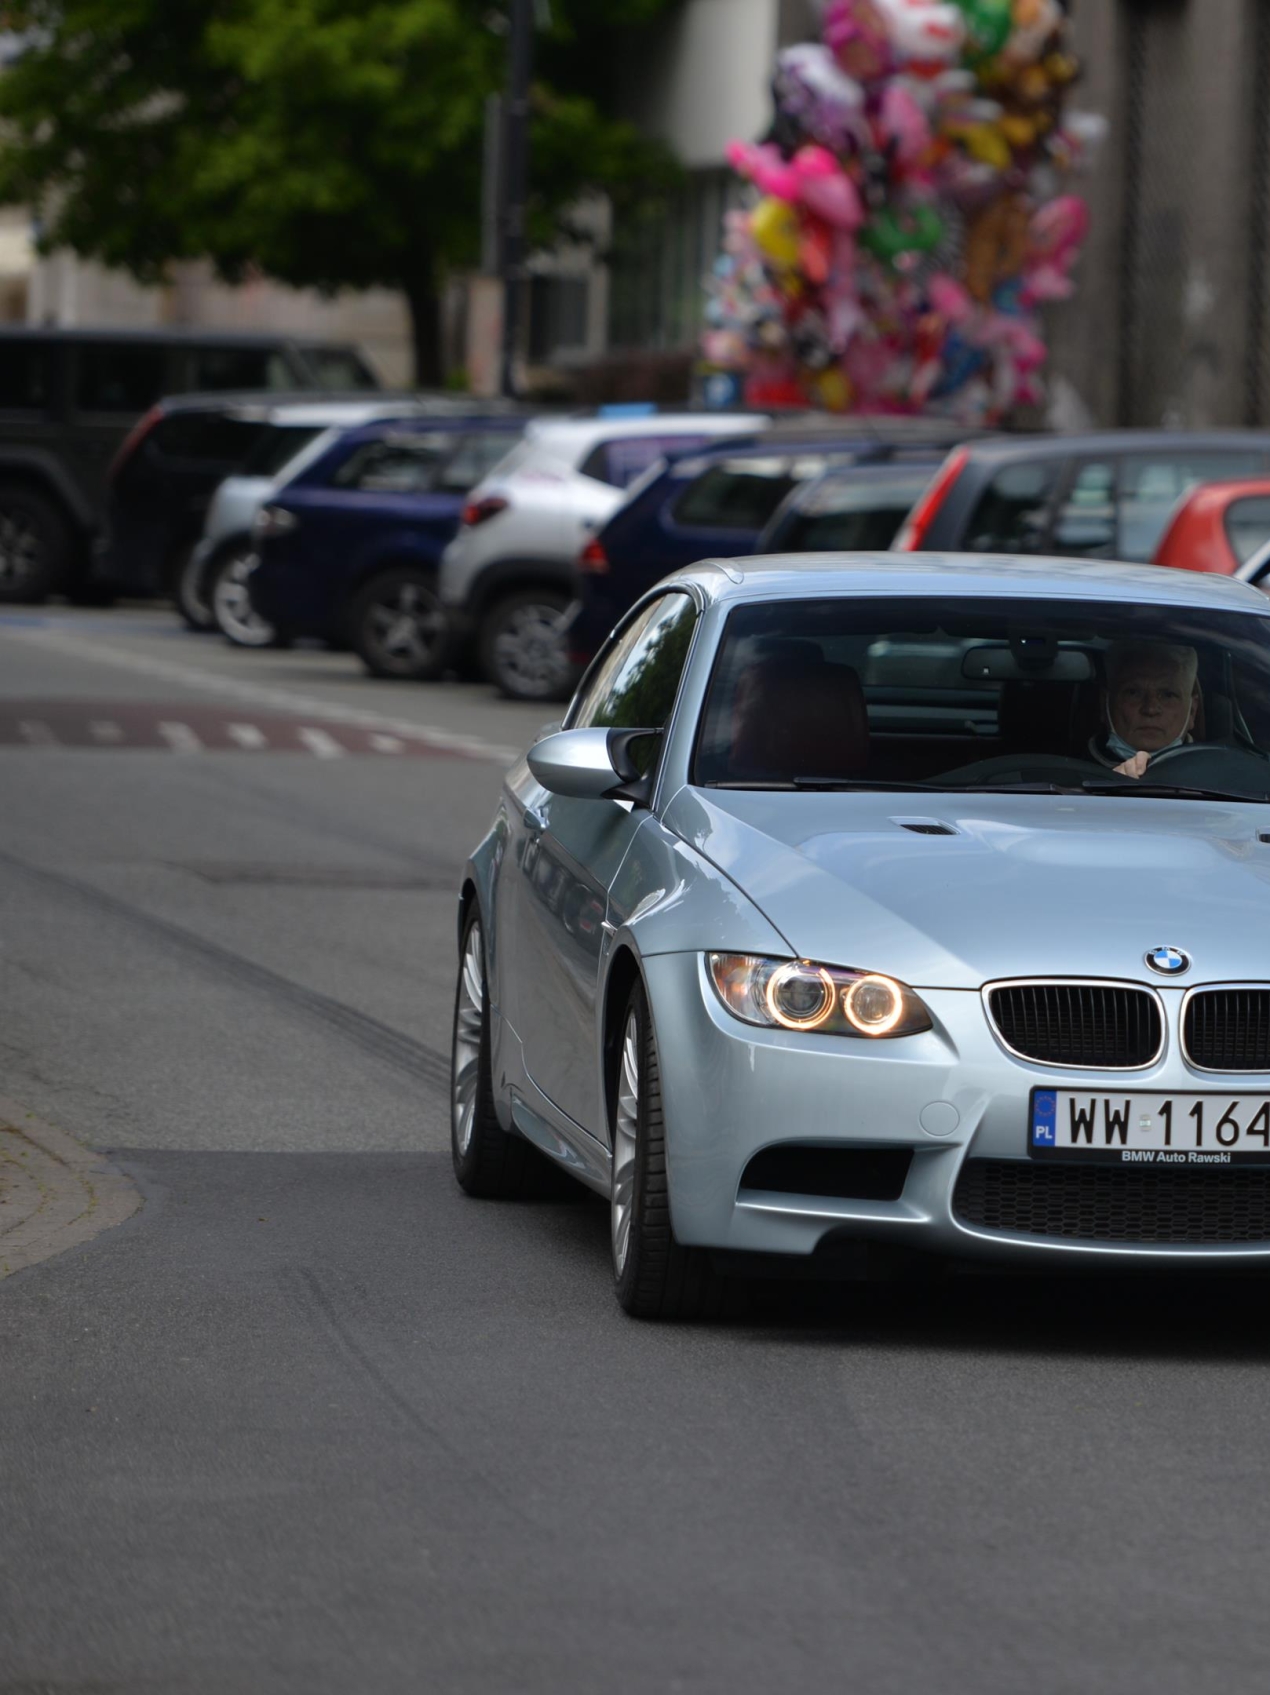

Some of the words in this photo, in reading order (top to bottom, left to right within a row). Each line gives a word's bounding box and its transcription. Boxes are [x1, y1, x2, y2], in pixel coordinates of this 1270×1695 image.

[1069, 1097, 1131, 1146] WW
[1035, 1126, 1053, 1139] PL
[1122, 1150, 1154, 1162] BMW
[1156, 1151, 1186, 1163] Auto
[1188, 1152, 1231, 1164] Rawski
